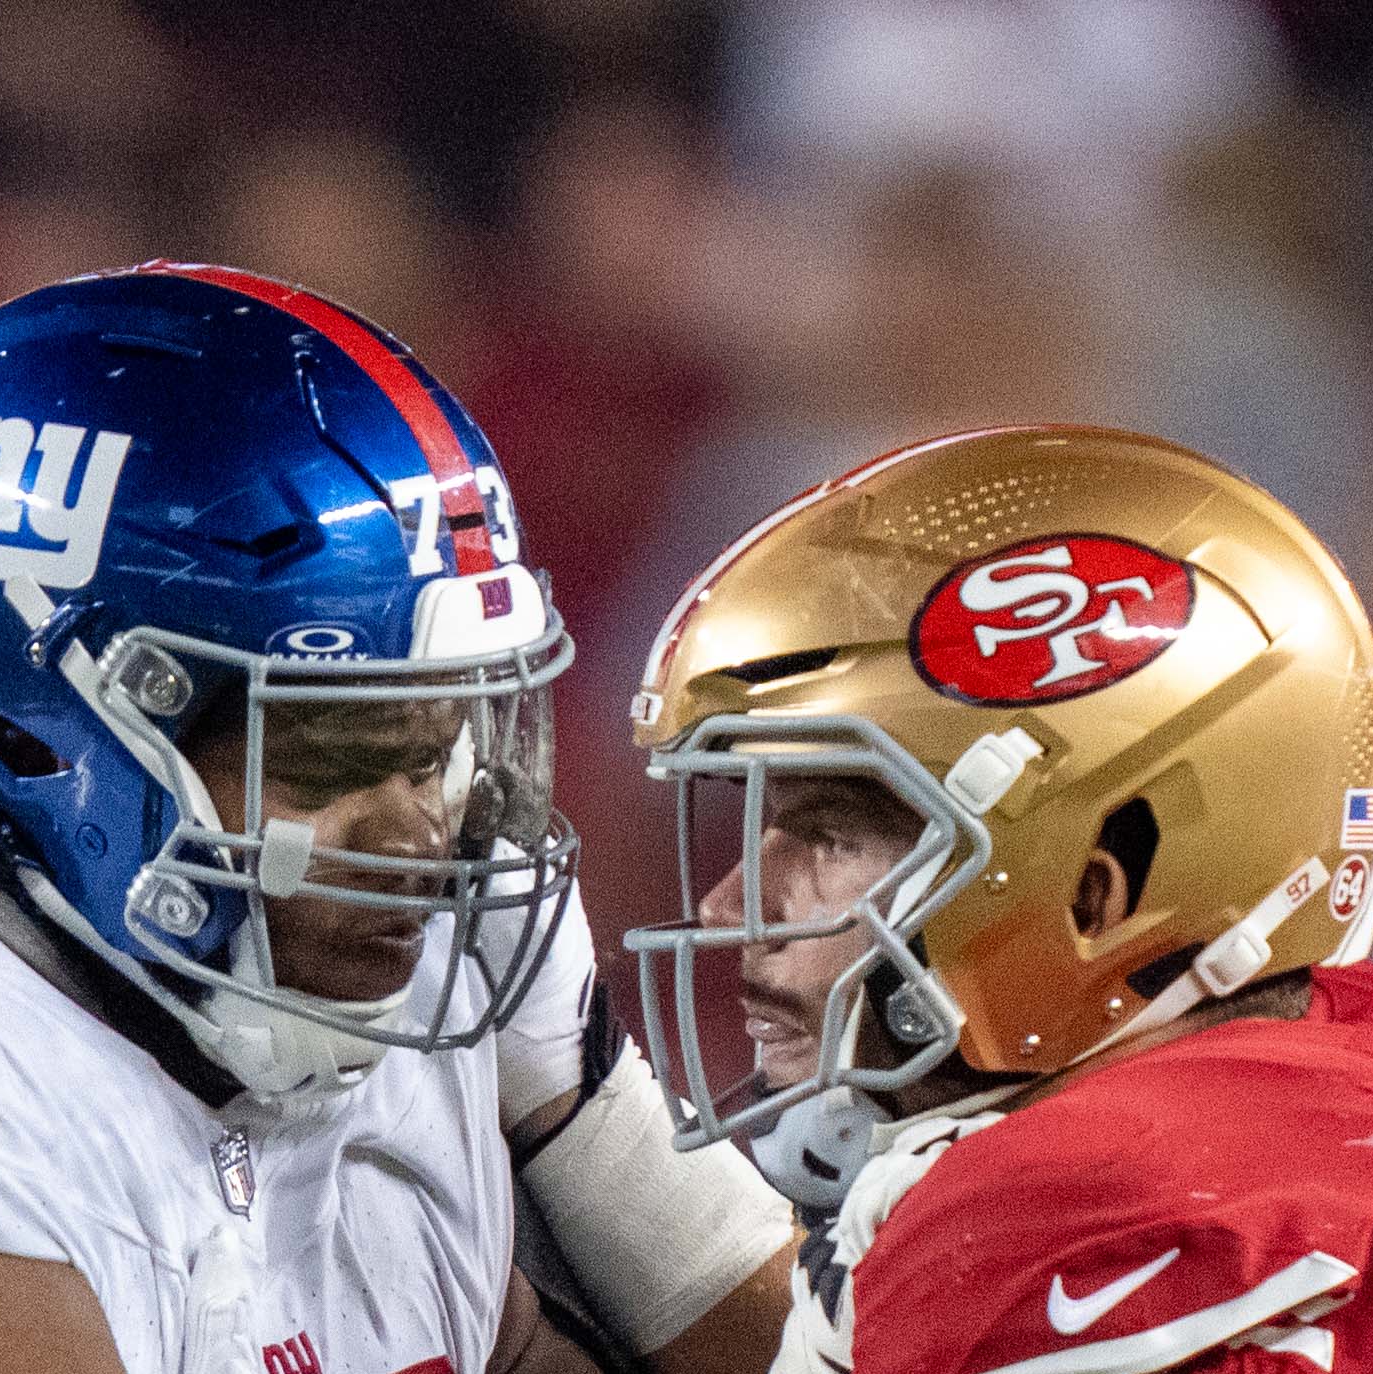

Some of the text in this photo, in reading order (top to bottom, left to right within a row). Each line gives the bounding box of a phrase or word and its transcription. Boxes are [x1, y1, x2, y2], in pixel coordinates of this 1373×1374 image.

[389, 465, 519, 577] 73
[959, 545, 1160, 688] SF
[1286, 872, 1311, 902] 97
[1333, 868, 1365, 908] 64
